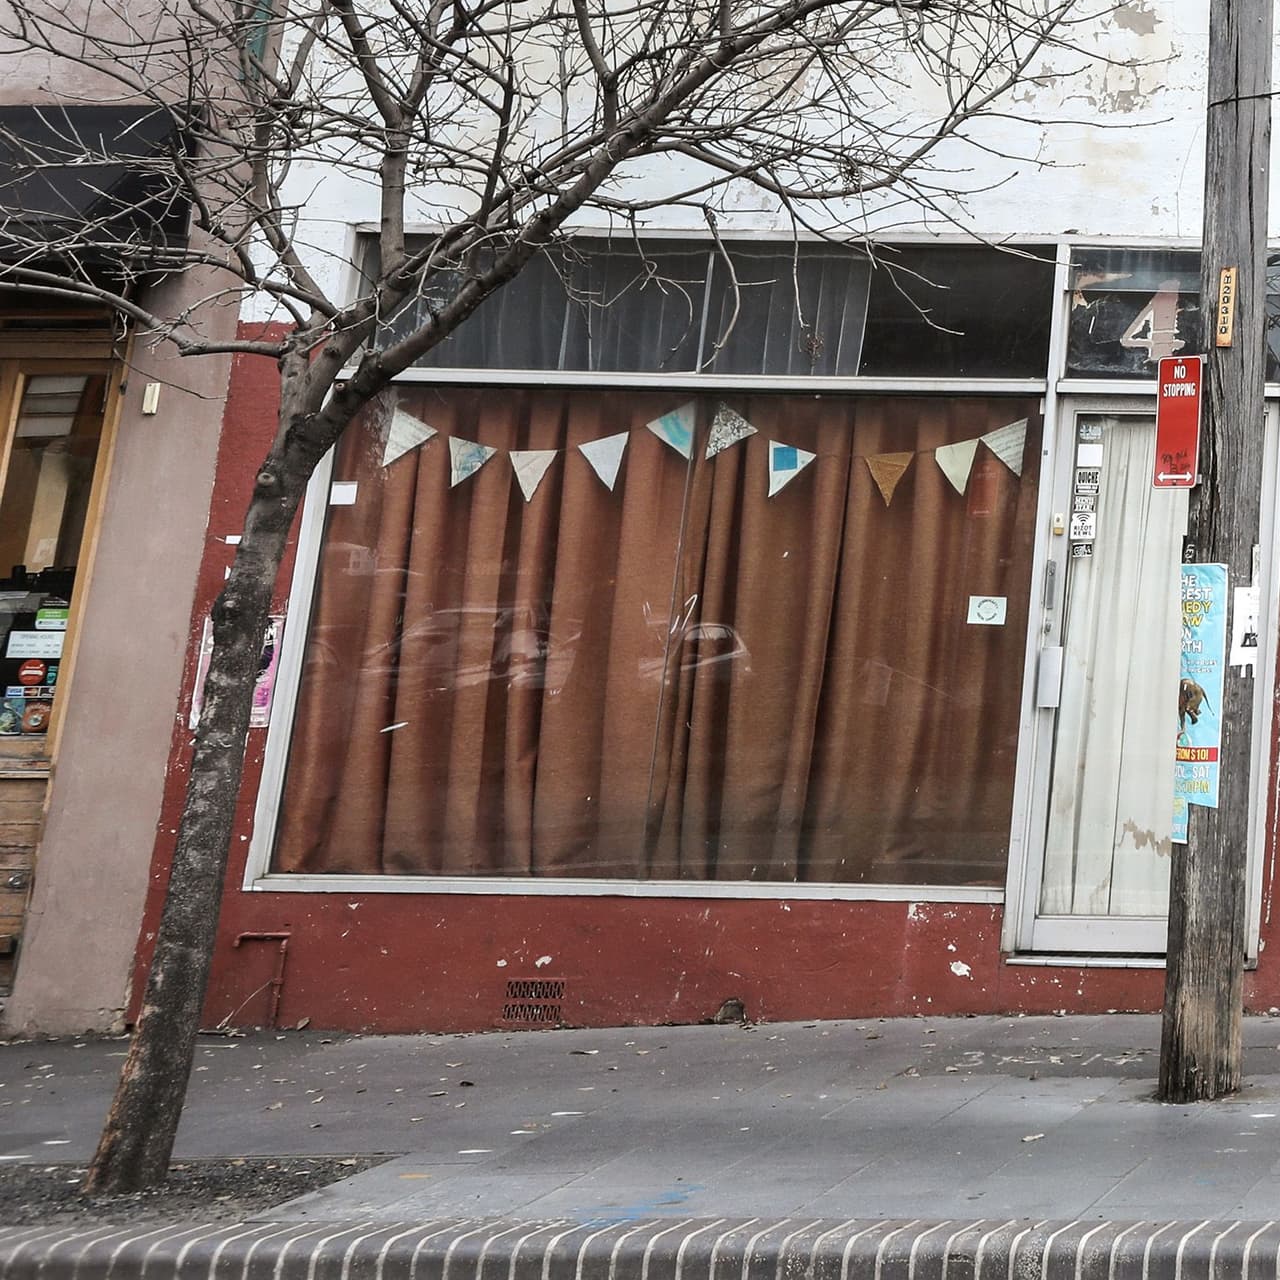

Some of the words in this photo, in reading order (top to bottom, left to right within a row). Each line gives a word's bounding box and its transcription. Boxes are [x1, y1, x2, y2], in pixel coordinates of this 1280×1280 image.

[1120, 280, 1186, 361] 4
[1174, 366, 1186, 379] NO
[1163, 383, 1196, 397] STOPPING
